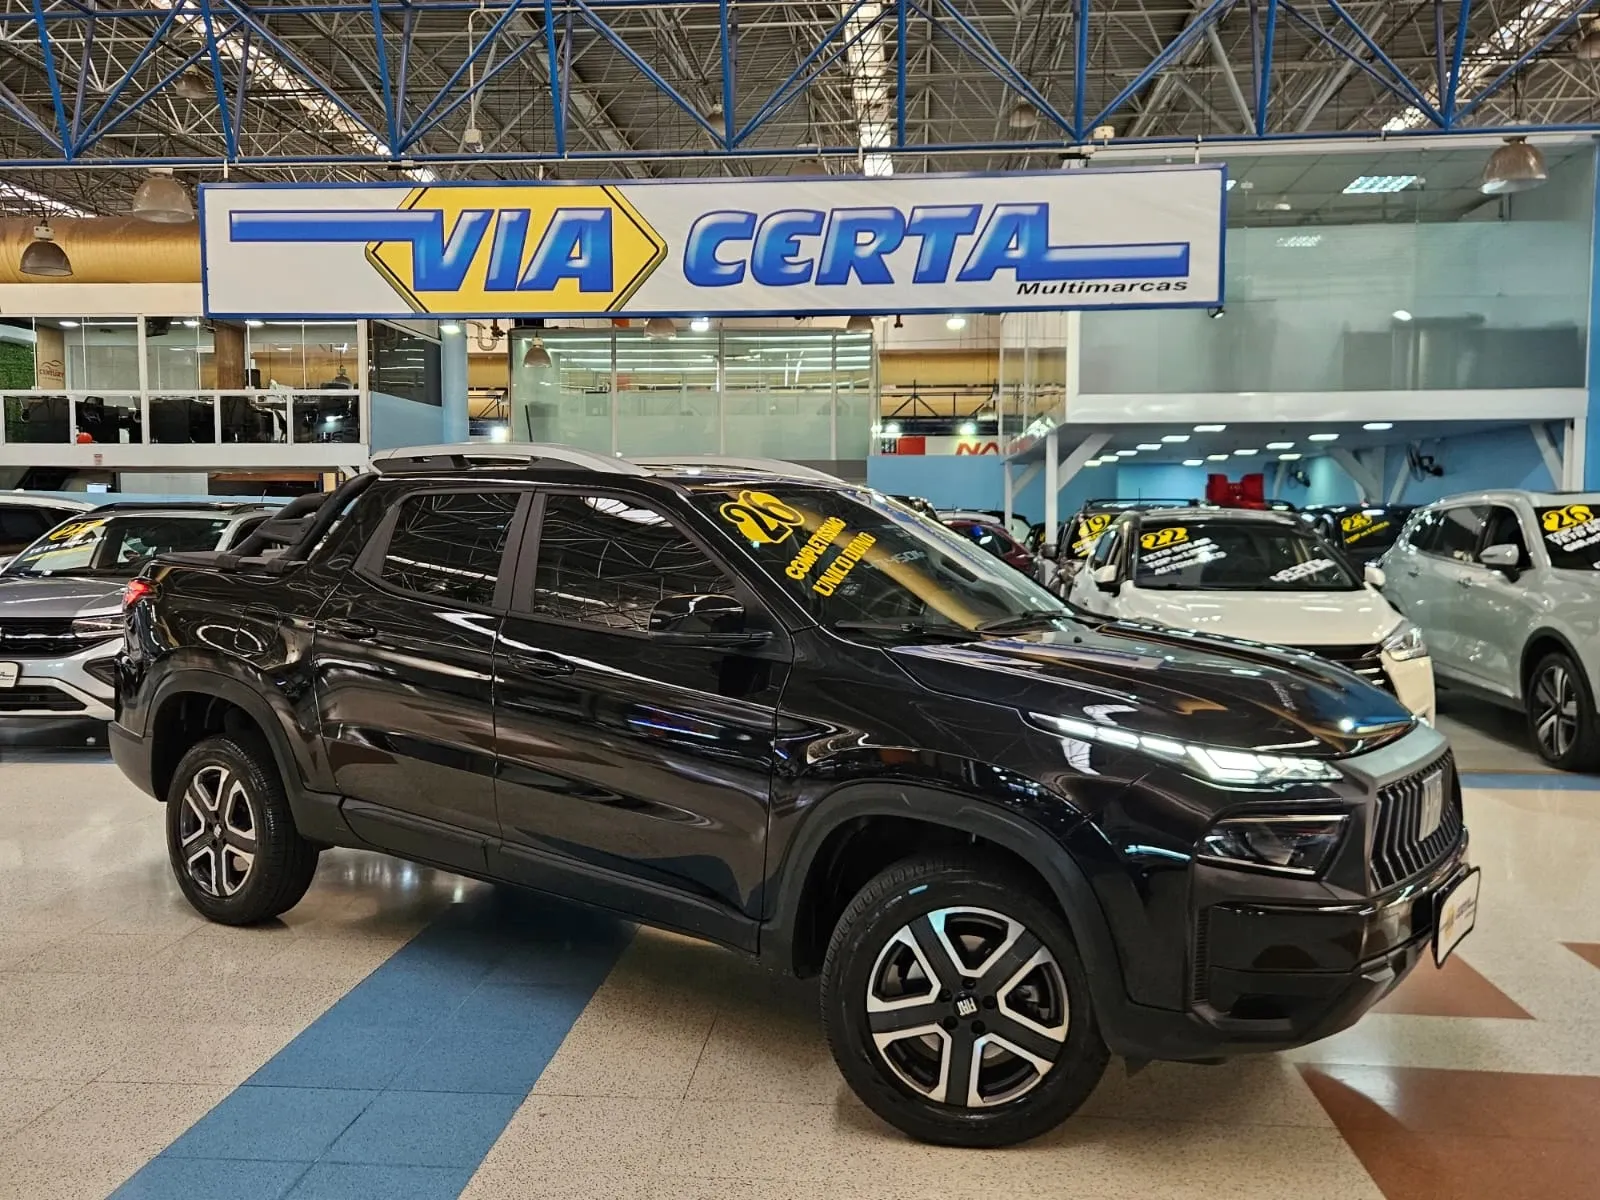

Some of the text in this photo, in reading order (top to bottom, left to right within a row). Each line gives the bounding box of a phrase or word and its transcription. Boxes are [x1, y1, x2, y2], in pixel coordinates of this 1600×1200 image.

[412, 202, 1050, 293] VIA CERTA
[1016, 278, 1189, 297] Multimarcas
[1083, 515, 1108, 536] 19
[1140, 527, 1190, 550] 22
